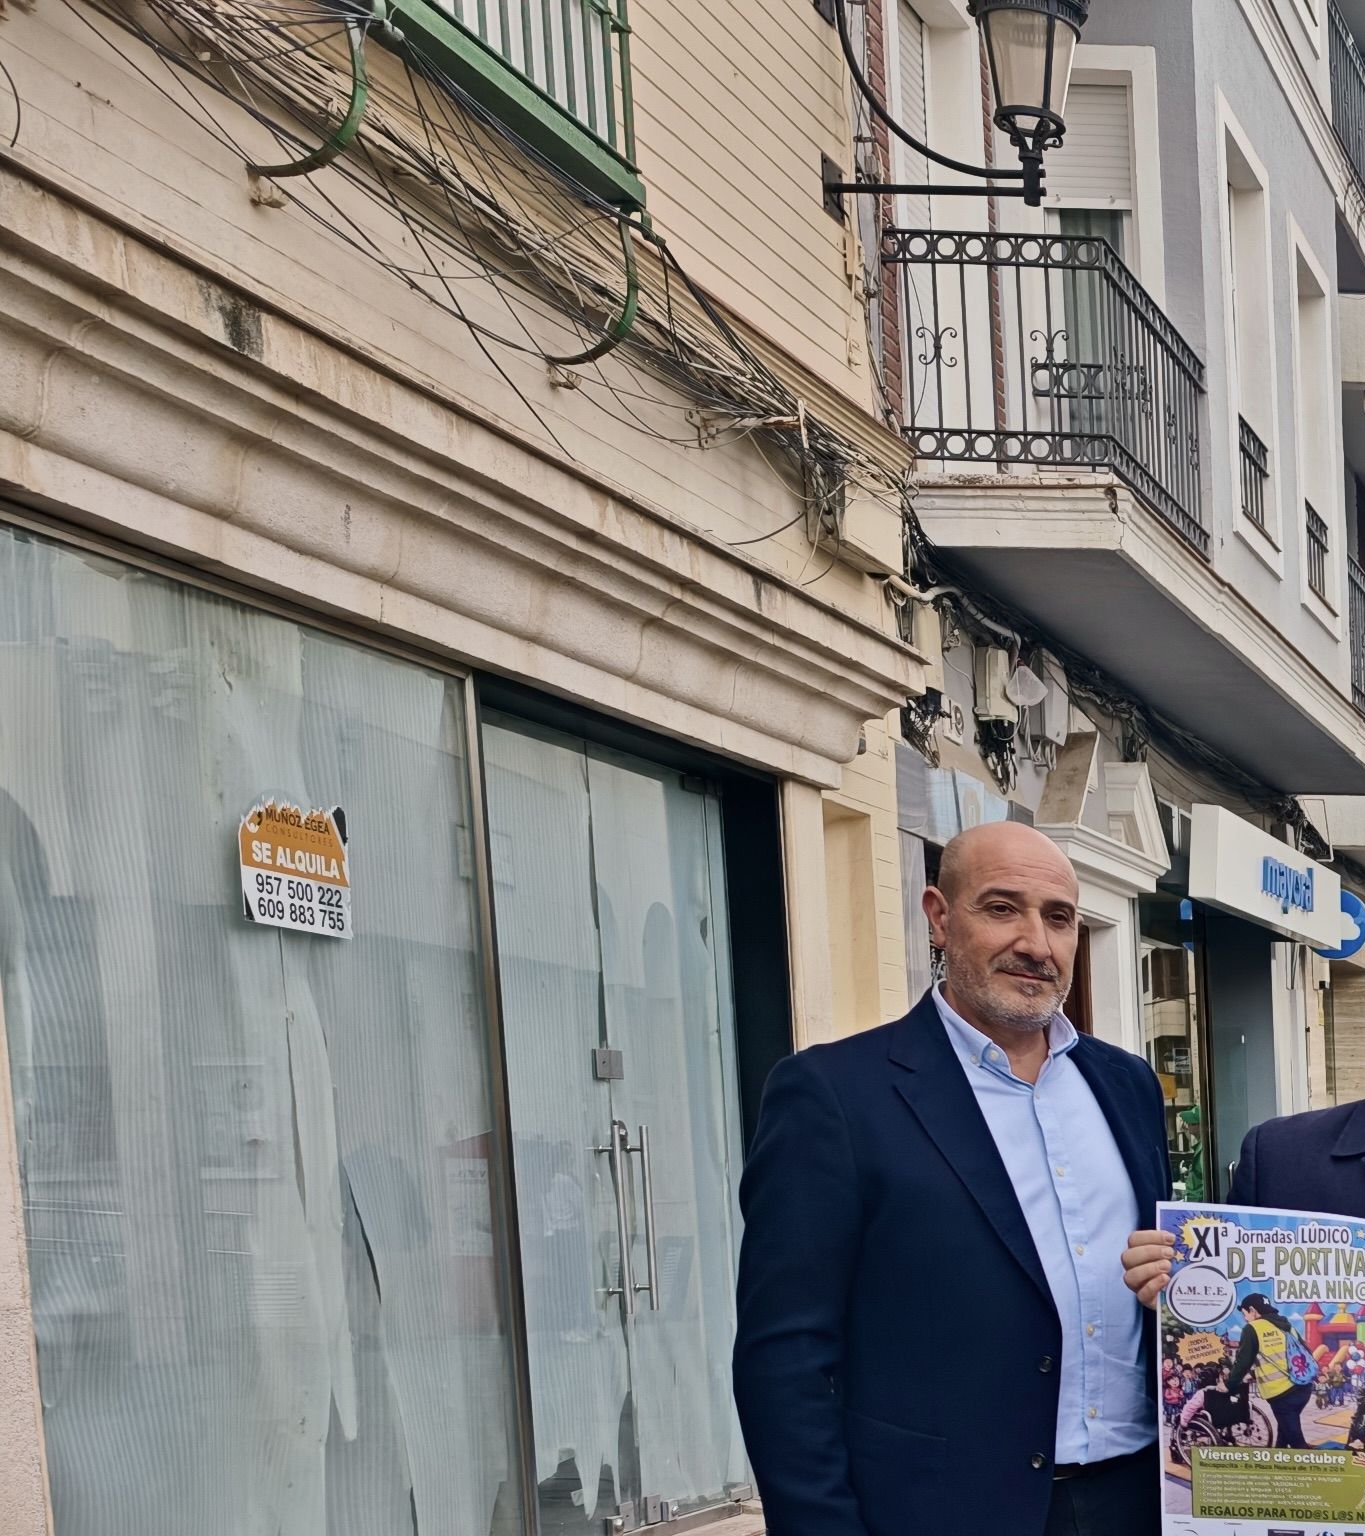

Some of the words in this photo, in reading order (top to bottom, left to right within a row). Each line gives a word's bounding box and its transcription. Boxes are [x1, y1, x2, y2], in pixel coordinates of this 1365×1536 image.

[305, 818, 330, 836] EGEA
[251, 840, 272, 864] SE
[276, 846, 340, 879] ALQUILA
[256, 873, 281, 895] 957
[288, 880, 313, 903] 500
[318, 886, 342, 908] 222
[1262, 856, 1313, 914] mayoral
[258, 897, 284, 920] 609
[289, 903, 315, 926] 883
[319, 909, 344, 931] 755
[1235, 1229, 1293, 1245] Jornadas
[1301, 1224, 1350, 1244] LÚDICO
[1277, 1279, 1321, 1300] PARA
[1199, 1449, 1249, 1460] Viernes
[1253, 1450, 1270, 1461] 30
[1273, 1451, 1291, 1462] de
[1294, 1453, 1346, 1465] octubre
[1200, 1506, 1254, 1518] REGALOS
[1257, 1507, 1286, 1518] PARA
[1289, 1509, 1329, 1520] TOD@S
